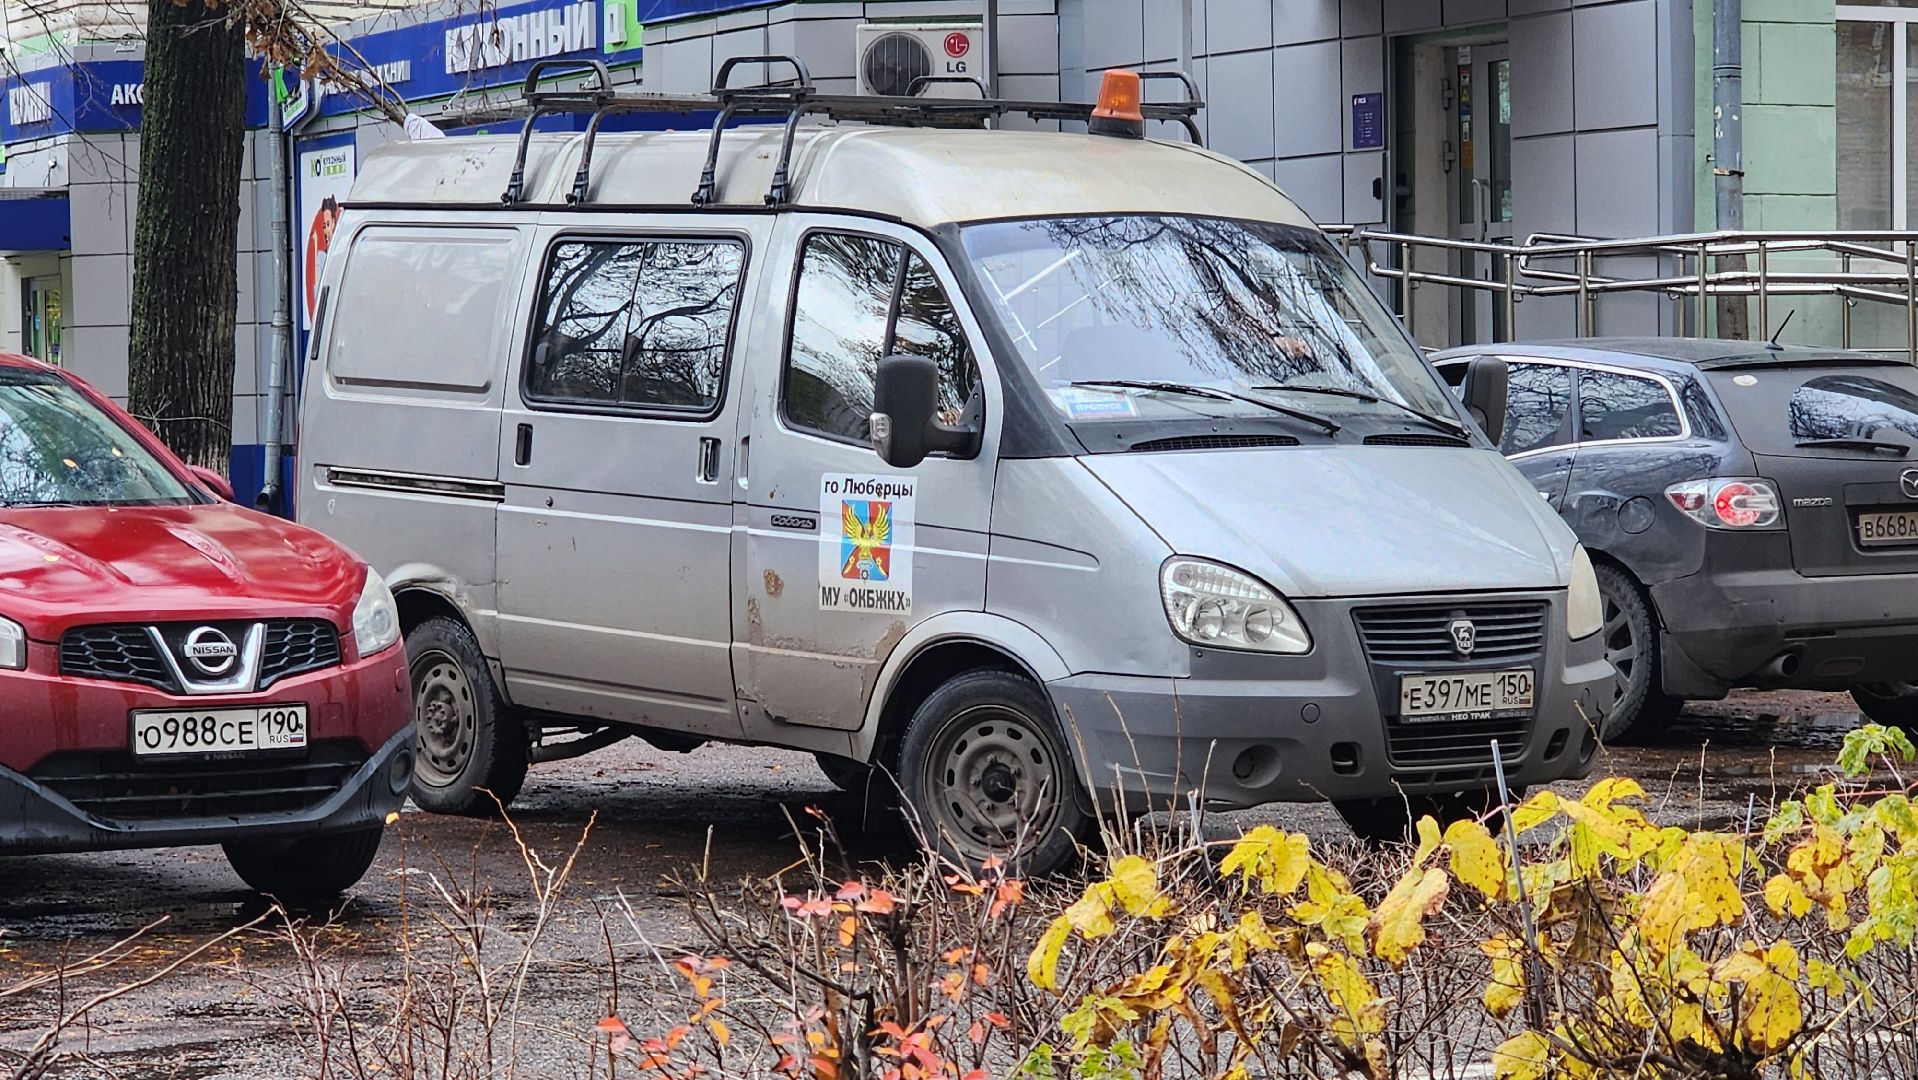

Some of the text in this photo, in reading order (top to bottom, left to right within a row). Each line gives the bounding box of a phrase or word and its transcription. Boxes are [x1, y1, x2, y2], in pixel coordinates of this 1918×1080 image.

[445, 1, 597, 74] КУХОННЫЙ
[946, 61, 967, 73] LG
[824, 478, 913, 499] го Люберцы
[1793, 498, 1832, 507] mazda
[821, 586, 911, 611] МУ «ОКБЖКХ»
[192, 645, 235, 655] NISSAN
[1409, 674, 1528, 710] Е397МЕ 150
[1502, 696, 1519, 705] RUS
[1451, 712, 1469, 721] НЕО
[1470, 711, 1491, 720] ТРАК
[143, 710, 300, 750] О988СЕ 190
[269, 734, 290, 744] RUS
